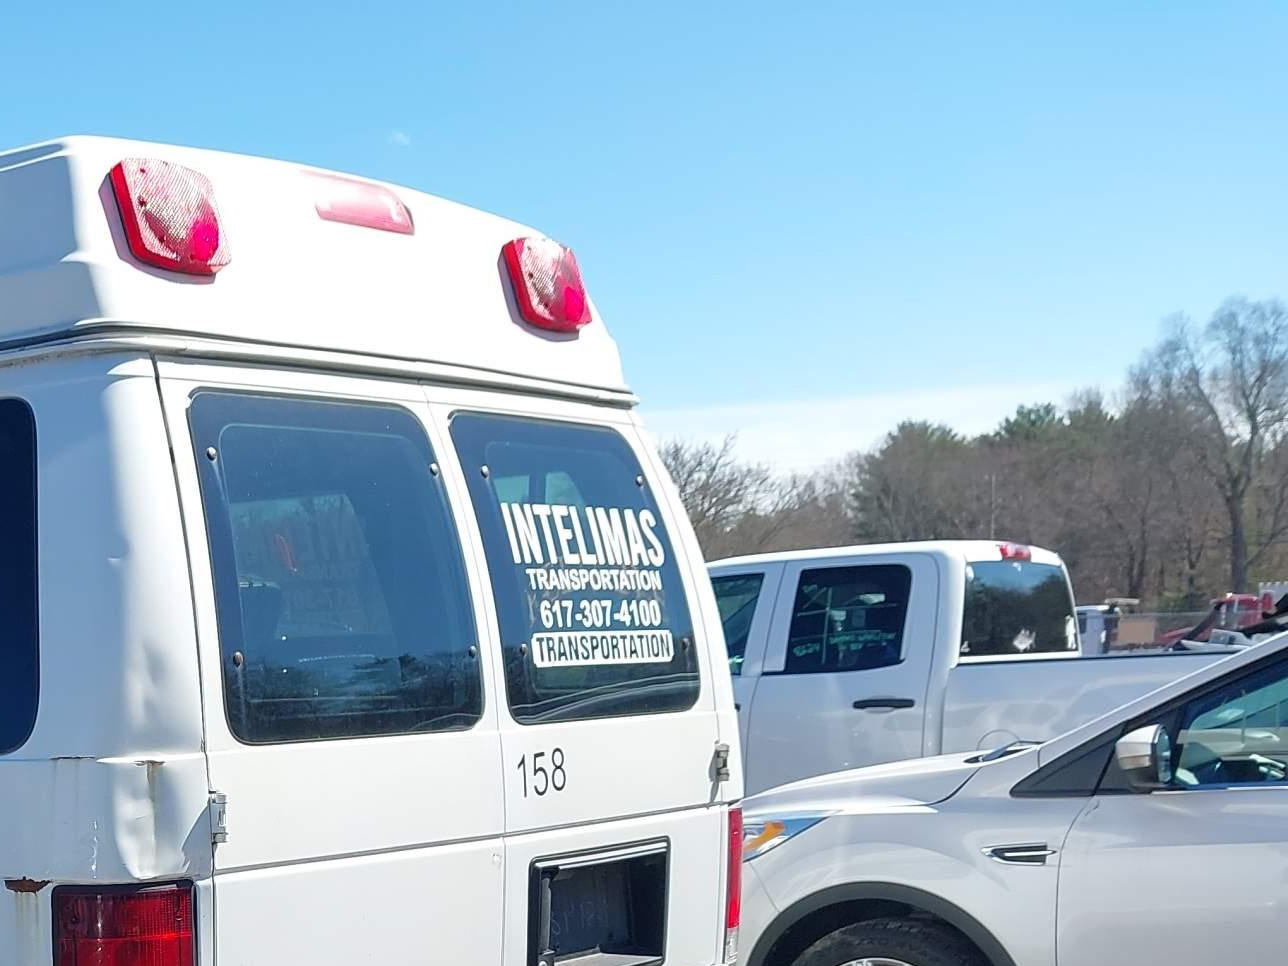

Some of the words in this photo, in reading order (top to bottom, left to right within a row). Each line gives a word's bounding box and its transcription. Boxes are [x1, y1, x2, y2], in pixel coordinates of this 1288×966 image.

[500, 502, 665, 567] INTELIMAS
[526, 568, 662, 591] TRANSPORTATION
[540, 599, 662, 629] 617-307-4100
[535, 635, 671, 663] TRANSPORTATION
[517, 747, 567, 798] 158
